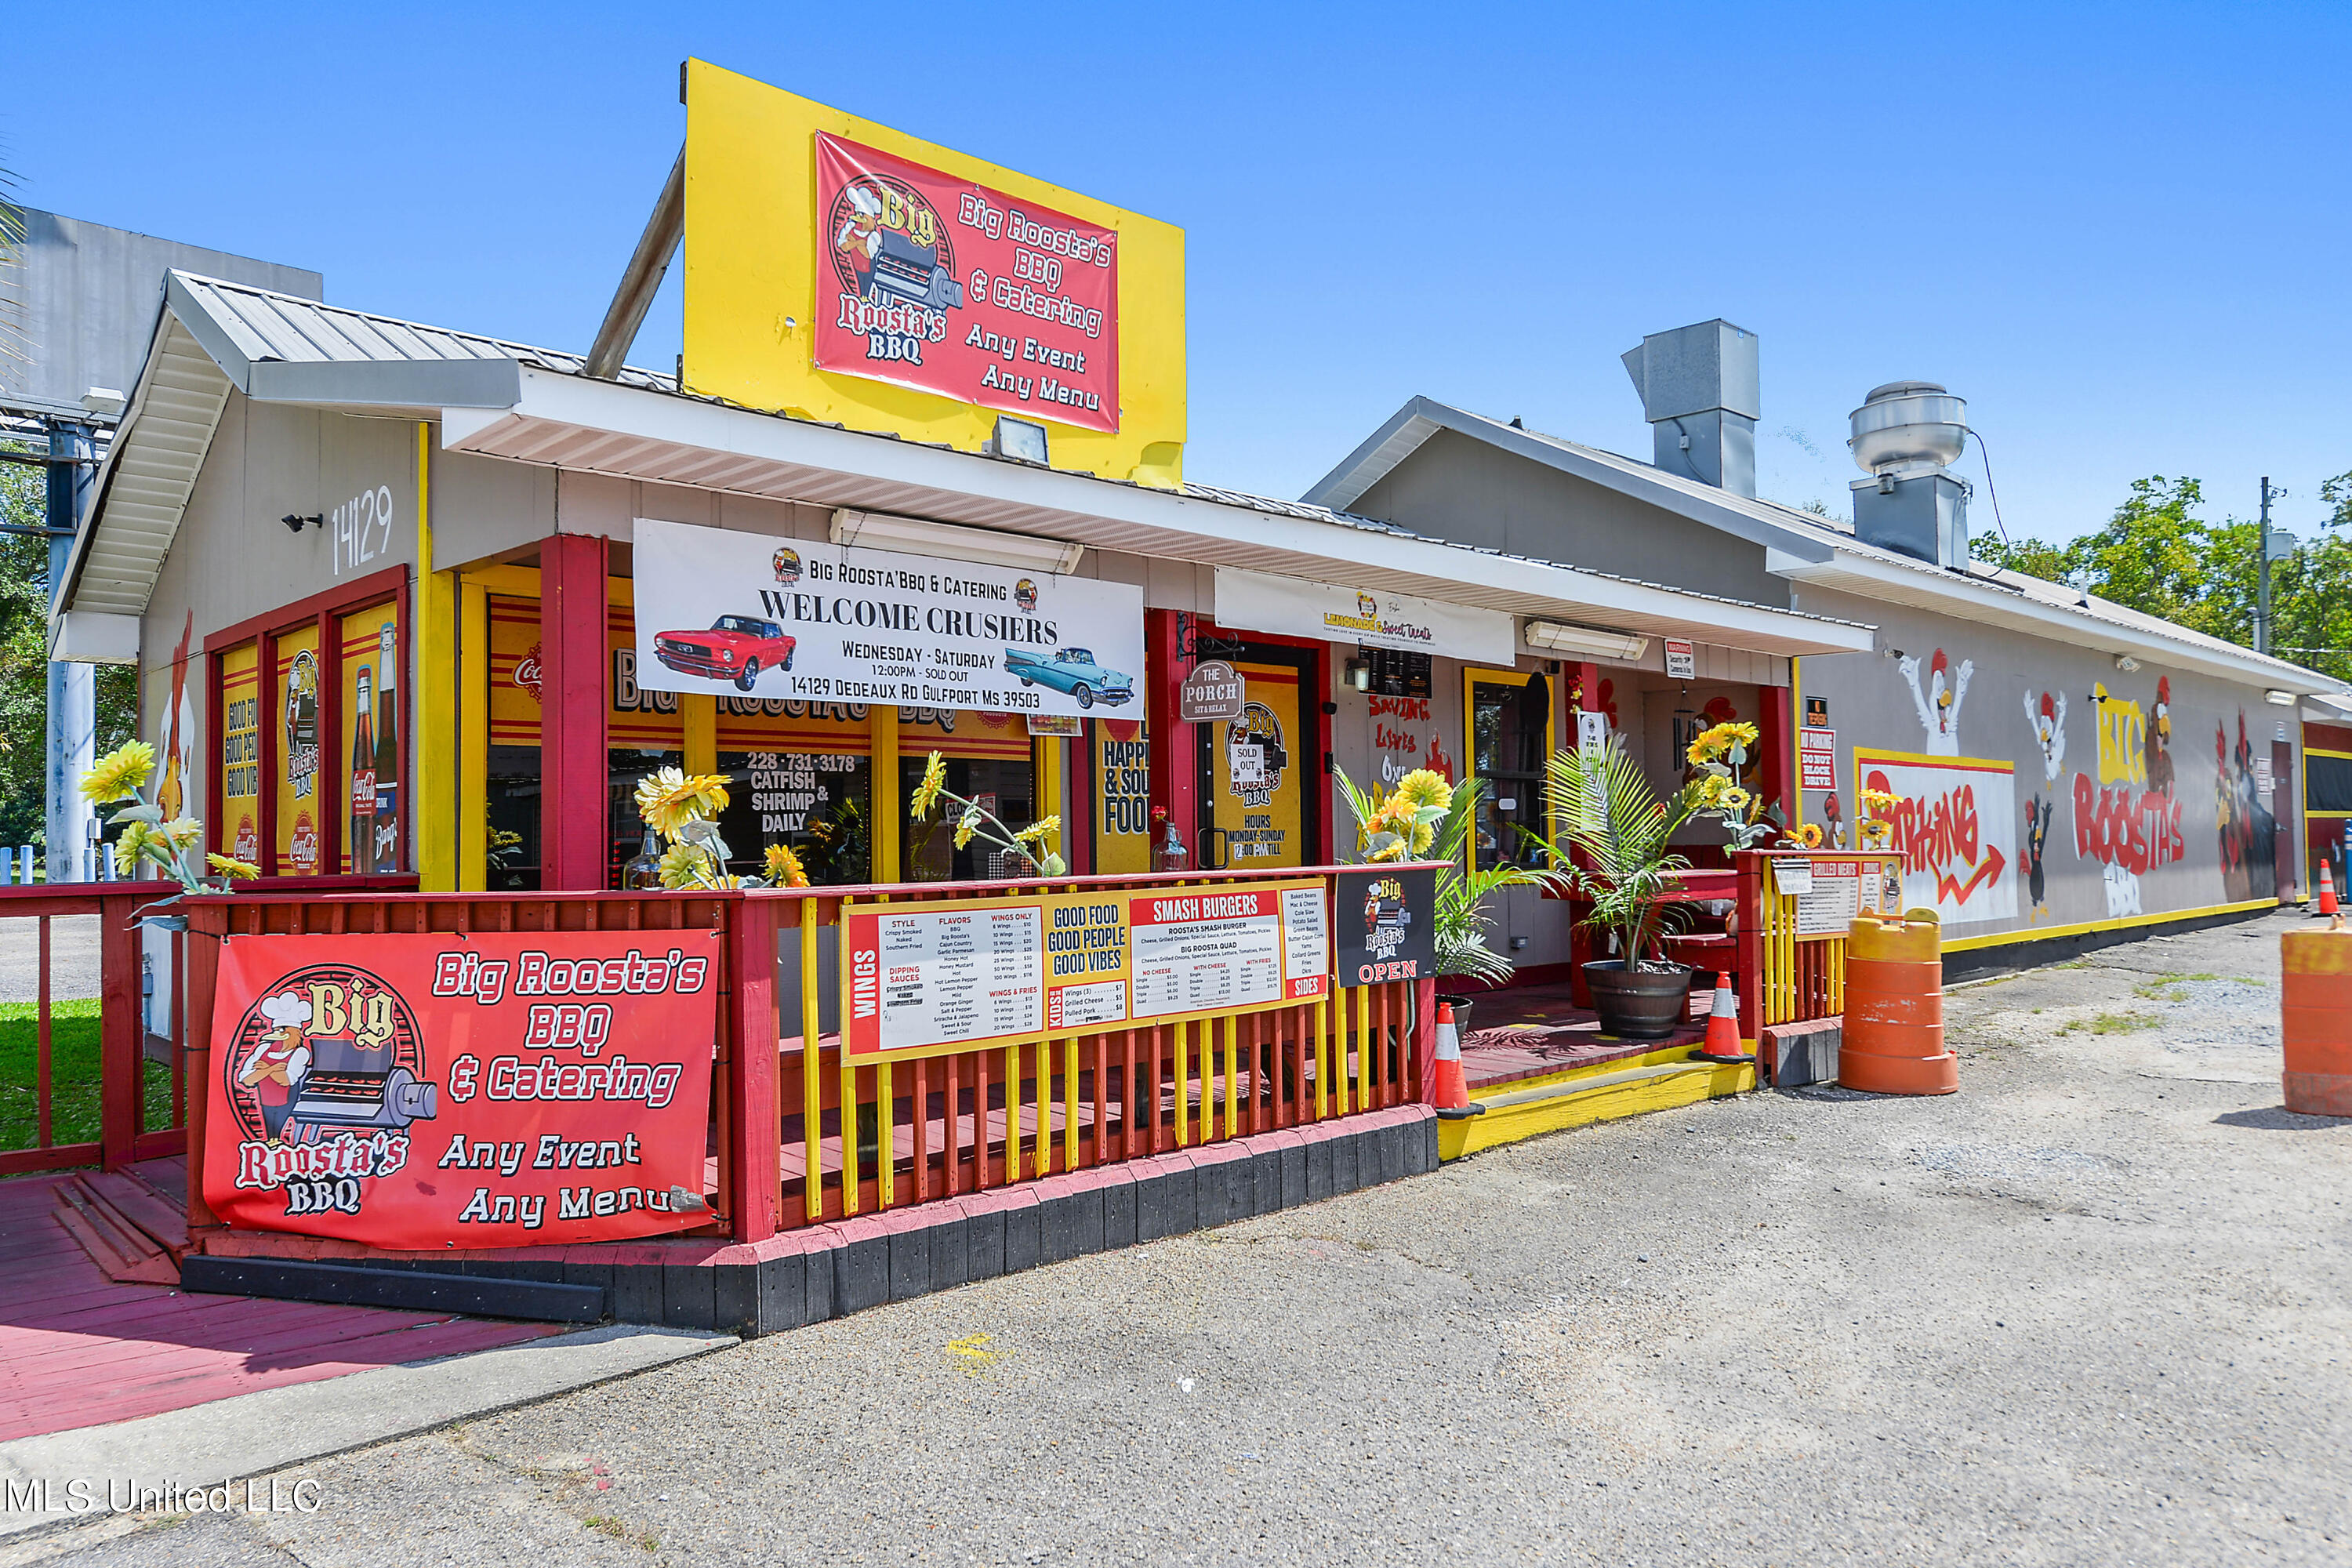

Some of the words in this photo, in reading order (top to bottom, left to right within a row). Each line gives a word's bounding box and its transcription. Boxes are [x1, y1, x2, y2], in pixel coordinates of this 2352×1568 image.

[877, 187, 937, 247] Big
[959, 193, 1004, 239] Big
[1007, 209, 1111, 268] Roosta's
[1014, 248, 1062, 292] BBQ
[839, 292, 946, 342] Roosta's
[970, 270, 988, 303] &
[993, 277, 1102, 338] Catering
[867, 332, 922, 365] BBQ
[965, 324, 1016, 360] Any
[1022, 338, 1086, 373] Event
[982, 364, 1031, 399] Any
[1038, 376, 1099, 410] Menu
[332, 485, 393, 575] 14129
[930, 574, 940, 592] &
[758, 588, 920, 634] WELCOME
[927, 607, 1058, 646] CRUSIERS
[1324, 612, 1375, 632] LEMONADE
[1382, 621, 1405, 637] Sweet
[872, 664, 914, 678] 12:00PM
[925, 668, 946, 681] SOLD
[947, 670, 968, 682] OUT
[1203, 668, 1220, 682] THE
[791, 676, 830, 695] 14129
[1004, 691, 1040, 709] 39503
[1185, 683, 1236, 702] PORCH
[247, 698, 257, 728] FO
[1194, 706, 1203, 714] SIT
[1208, 704, 1227, 713] RELAX
[1247, 710, 1273, 738] Big
[2094, 681, 2147, 785] BIG
[244, 731, 257, 763] PEO
[1238, 749, 1257, 757] SOLD
[1802, 754, 1813, 763] DO
[1814, 754, 1831, 764] NOT
[1240, 761, 1255, 770] OUT
[1803, 765, 1831, 775] BLOCK
[245, 766, 257, 797] VIB
[750, 771, 815, 789] CATFISH
[1105, 768, 1119, 796] &
[1120, 769, 1149, 797] SOU
[1804, 776, 1831, 786] DRIVE
[751, 793, 815, 811] SHRIMP
[817, 786, 829, 801] &
[1245, 789, 1270, 806] BBQ
[762, 813, 806, 833] DAILY
[1104, 796, 1149, 834] FOO
[1244, 815, 1271, 828] HOURS
[1229, 830, 1285, 842] MONDAY-SUNDAY
[1269, 844, 1281, 855] TILL
[1380, 877, 1401, 901] Big
[939, 916, 971, 925] FLAVORS
[1054, 907, 1086, 928] GOOD
[1089, 905, 1118, 926] FOOD
[1153, 898, 1200, 922] SMASH
[1203, 895, 1258, 919] BURGERS
[1048, 930, 1080, 953] GOOD
[1083, 927, 1126, 949] PEOPLE
[1168, 925, 1200, 935] ROOSTA'S
[1365, 929, 1405, 952] Roosta's
[1054, 953, 1085, 975] GOOD
[1087, 949, 1121, 972] VIBES
[1376, 946, 1396, 960] BBQ
[432, 950, 508, 1004] Big
[514, 949, 707, 996] Roosta's
[889, 966, 920, 975] DIPPING
[890, 975, 920, 983] SAUCES
[1359, 960, 1417, 983] OPEN
[854, 949, 876, 1019] WINGS
[1295, 977, 1319, 996] SIDES
[305, 975, 395, 1048] Big
[1049, 996, 1062, 1027] KIDS
[524, 1004, 612, 1057] BBQ
[448, 1054, 479, 1102] &
[487, 1055, 682, 1107] Catering
[235, 1127, 410, 1189] Roosta's
[438, 1134, 524, 1177] Any
[532, 1133, 641, 1170] Event
[287, 1177, 361, 1215] BBQ
[459, 1187, 546, 1229] Any
[557, 1185, 672, 1221] Menu
